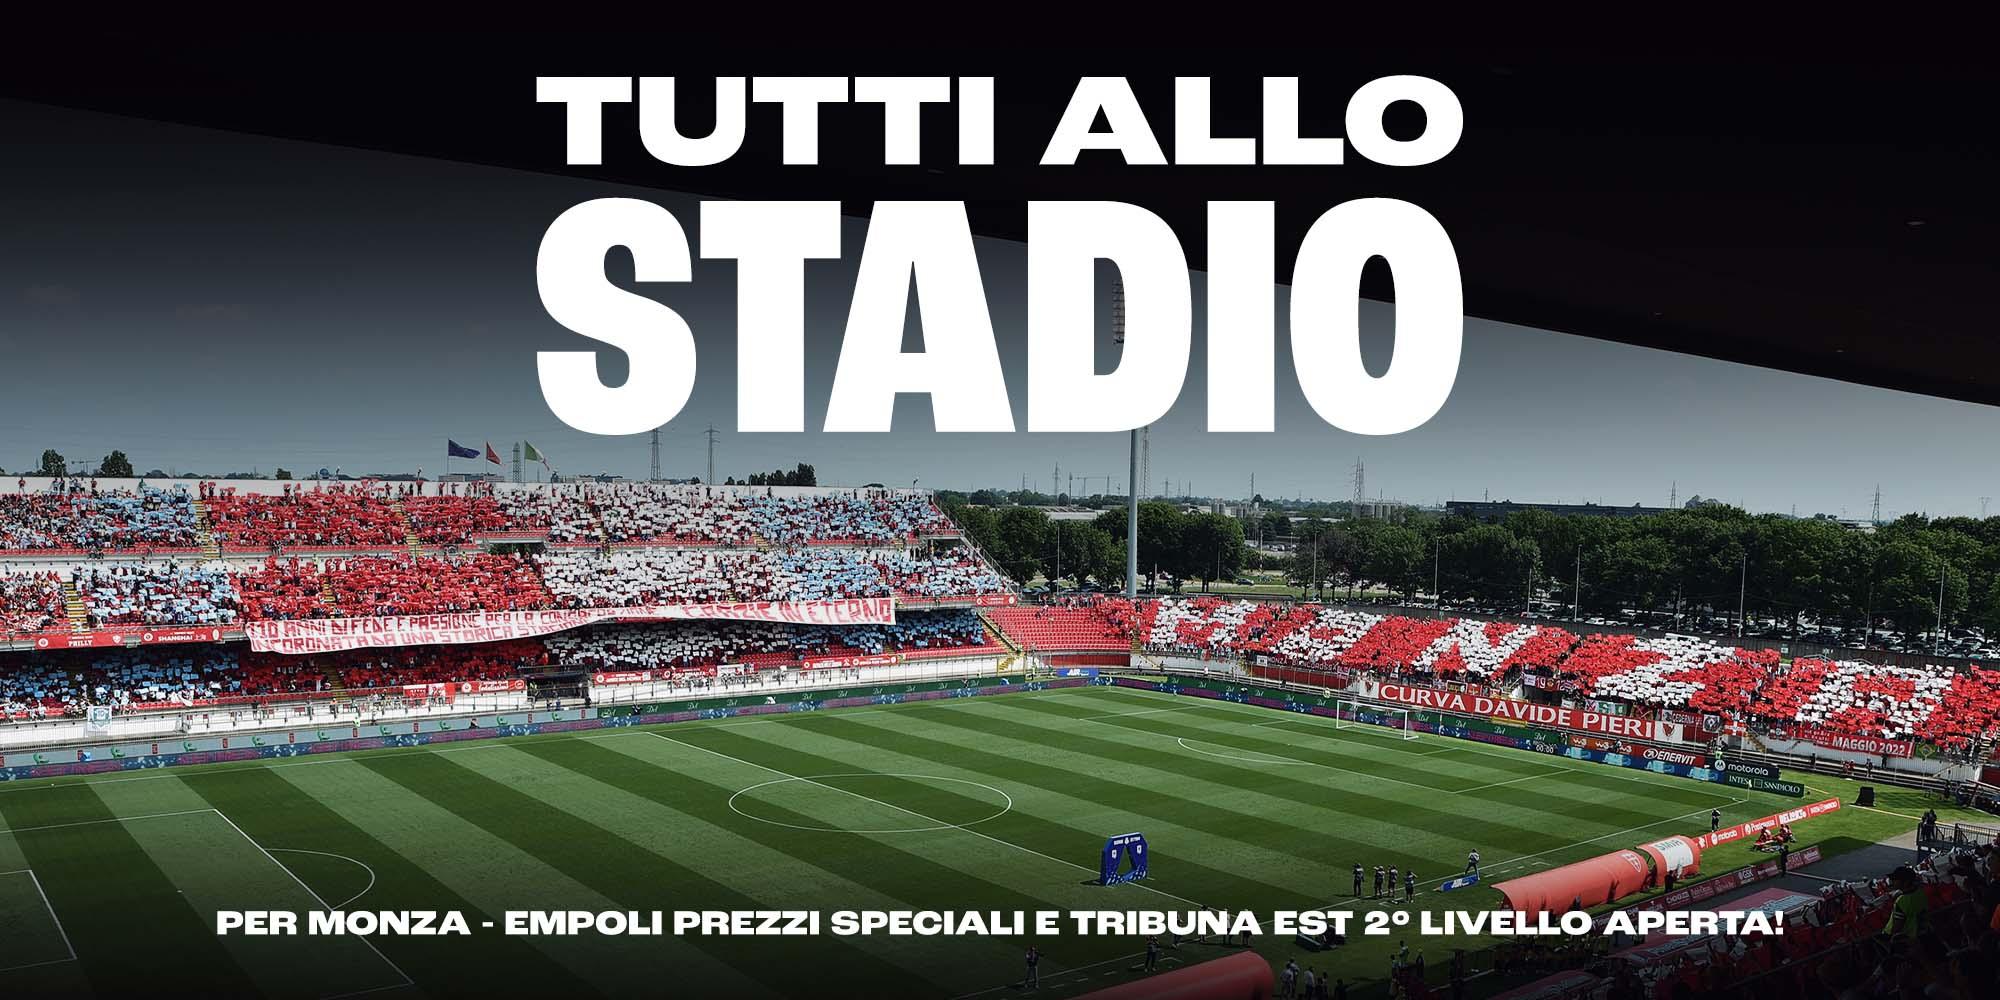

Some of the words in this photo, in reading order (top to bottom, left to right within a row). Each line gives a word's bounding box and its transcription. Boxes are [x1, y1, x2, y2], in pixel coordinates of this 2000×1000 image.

[249, 622, 278, 638] 110
[284, 620, 325, 636] ANNI
[351, 617, 393, 634] FEDE
[410, 613, 480, 631] PASSIONE
[807, 599, 891, 623] ETERNO
[401, 632, 433, 645] UNA
[439, 626, 512, 643] STORICA
[1379, 684, 1466, 712] CURVA
[1473, 697, 1574, 727] DAVIDE
[1582, 711, 1652, 739] PIERI
[1833, 737, 1876, 752] MAGGIO
[1879, 743, 1906, 756] 2022
[1657, 750, 1696, 765] ENERVIT
[1728, 763, 1769, 776] motorola
